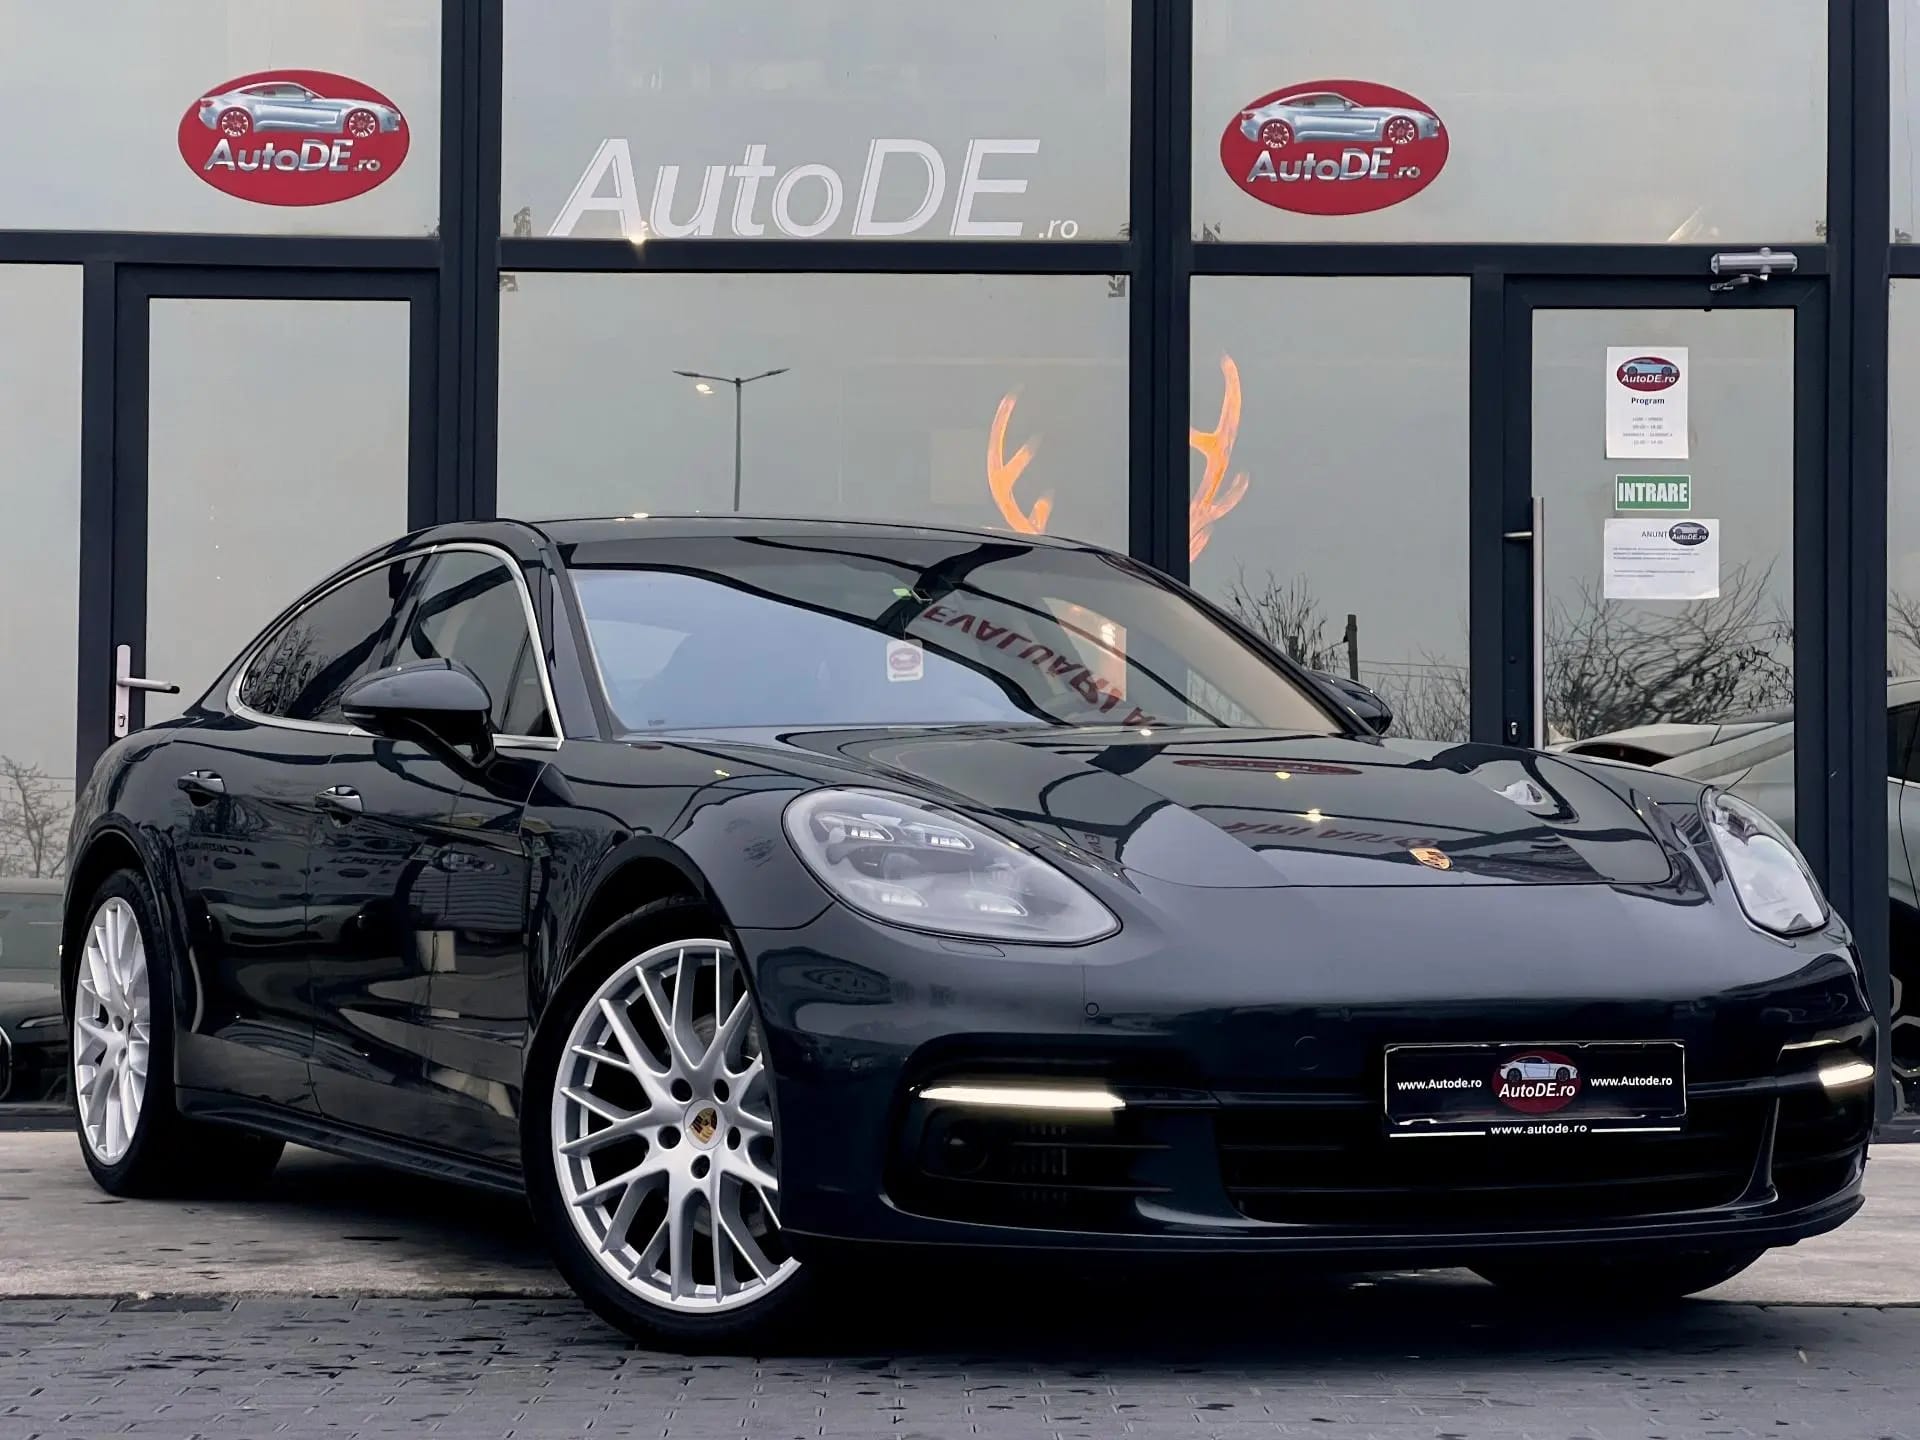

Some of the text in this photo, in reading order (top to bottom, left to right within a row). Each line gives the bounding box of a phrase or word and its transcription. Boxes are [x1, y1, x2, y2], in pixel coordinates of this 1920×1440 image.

[1631, 397, 1665, 406] Program
[1618, 482, 1688, 502] INTRARE
[1397, 1077, 1483, 1091] www.Autode.ro
[1590, 1075, 1673, 1087] www.Autode.ro
[1498, 1082, 1576, 1099] AutoDE.ro
[1490, 1122, 1588, 1135] www.autode.ro
